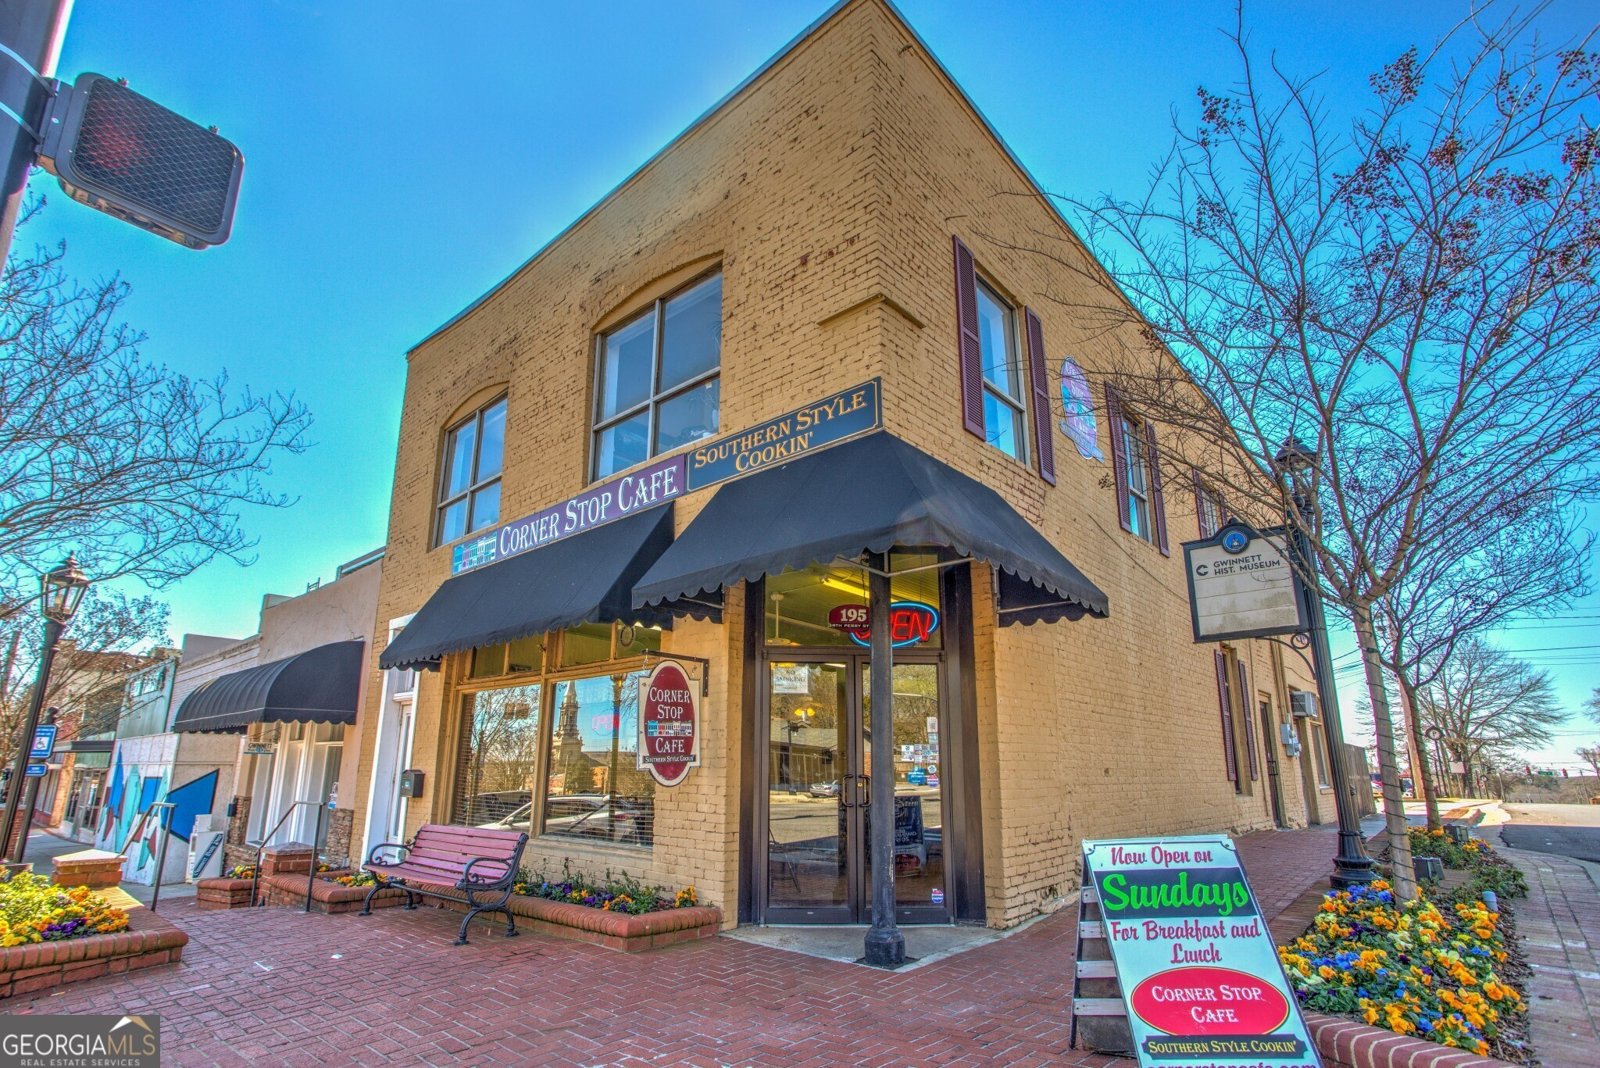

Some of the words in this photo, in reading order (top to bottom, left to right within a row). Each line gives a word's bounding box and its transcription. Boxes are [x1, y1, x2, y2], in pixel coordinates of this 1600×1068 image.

[694, 419, 791, 469] SOUTHERN
[795, 390, 868, 432] STYLE
[735, 431, 815, 472] COOKIN'
[500, 512, 560, 556] CORNER
[564, 492, 613, 533] STOP
[618, 465, 680, 513] CAFE
[1213, 554, 1262, 568] GWINNETT
[1214, 567, 1236, 576] HIST.
[1239, 560, 1280, 572] MUSEUM
[840, 608, 867, 622] 195
[649, 687, 690, 703] CORNER
[657, 704, 684, 719] STOP
[655, 738, 685, 753] CAFE
[1111, 846, 1147, 865] Now
[1151, 845, 1191, 868] Open
[1194, 849, 1213, 863] on
[1102, 871, 1249, 917] Sundays
[1111, 920, 1139, 941] For
[1142, 919, 1227, 942] Breakfast
[1231, 917, 1262, 938] and
[1170, 942, 1222, 964] Lunch
[1151, 985, 1217, 1002] CORNER
[1219, 984, 1262, 1001] STOP
[1191, 1006, 1239, 1023] CAFE
[1148, 1041, 1209, 1054] SOUTHERN
[1210, 1040, 1250, 1053] STYLE
[1251, 1040, 1297, 1053] COOKIN'
